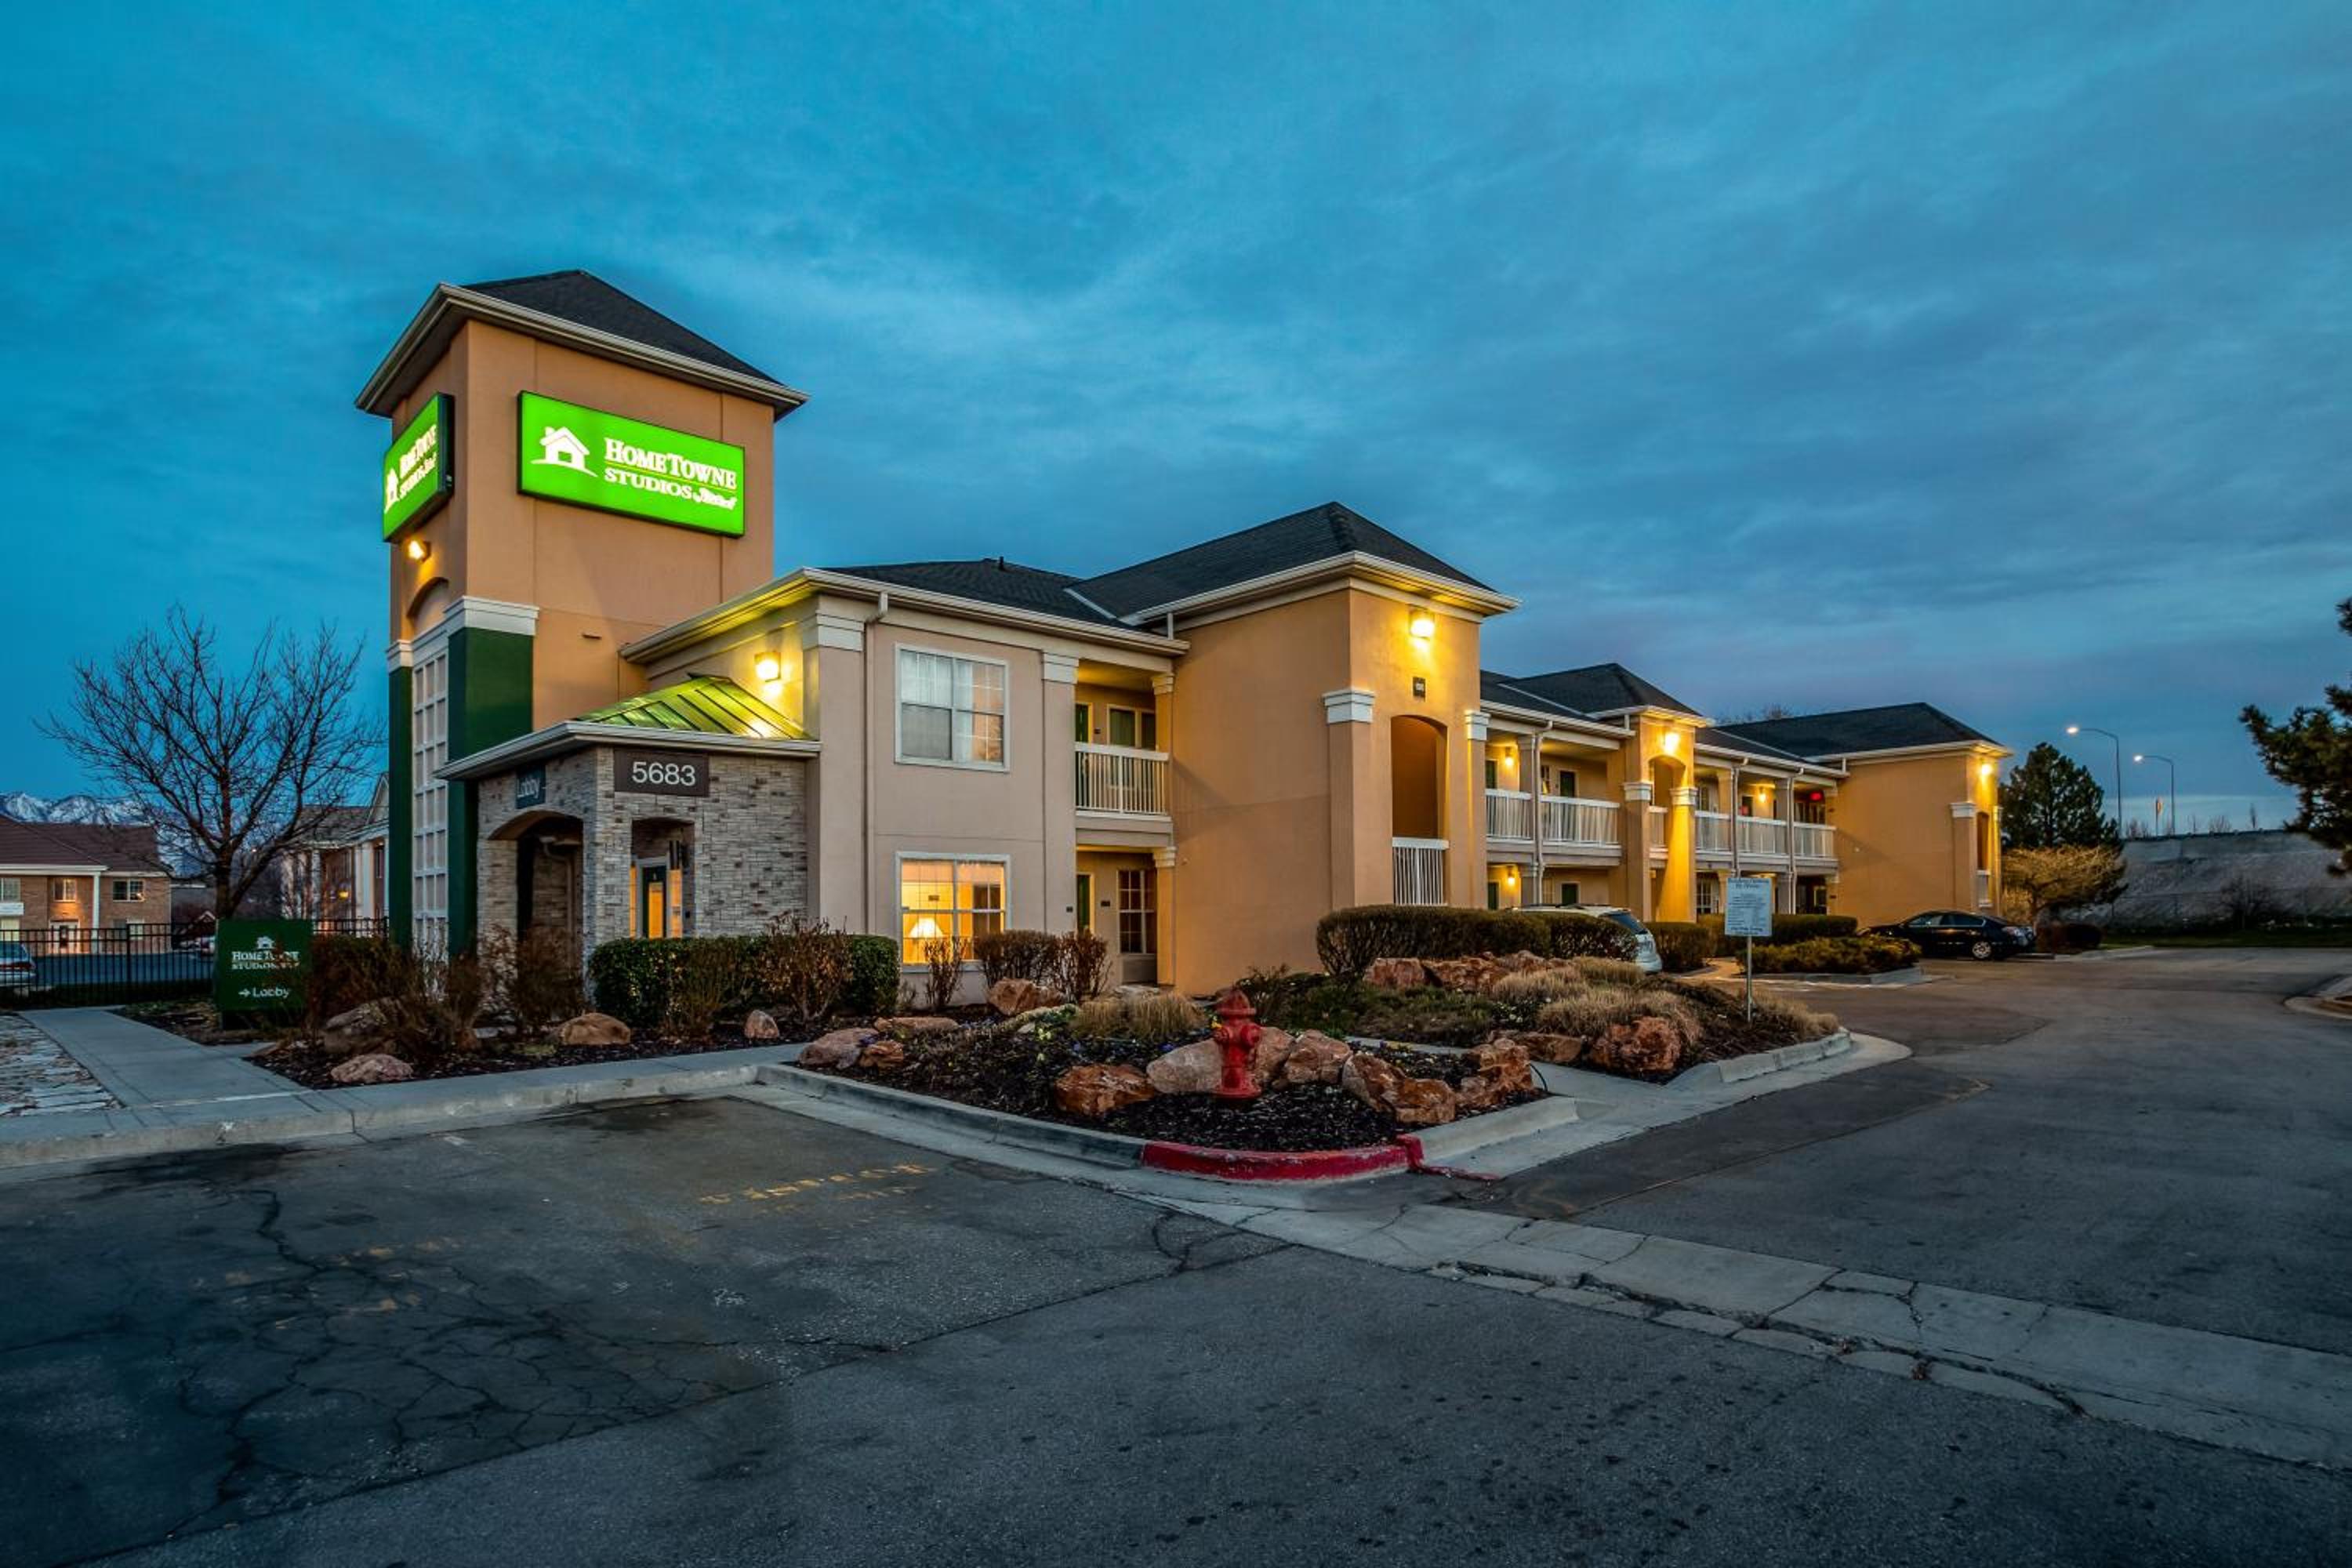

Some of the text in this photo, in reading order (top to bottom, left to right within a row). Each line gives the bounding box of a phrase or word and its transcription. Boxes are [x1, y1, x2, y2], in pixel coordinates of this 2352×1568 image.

[604, 469, 691, 498] STUDIOS
[631, 761, 696, 786] 5683
[252, 987, 289, 999] Lobby
